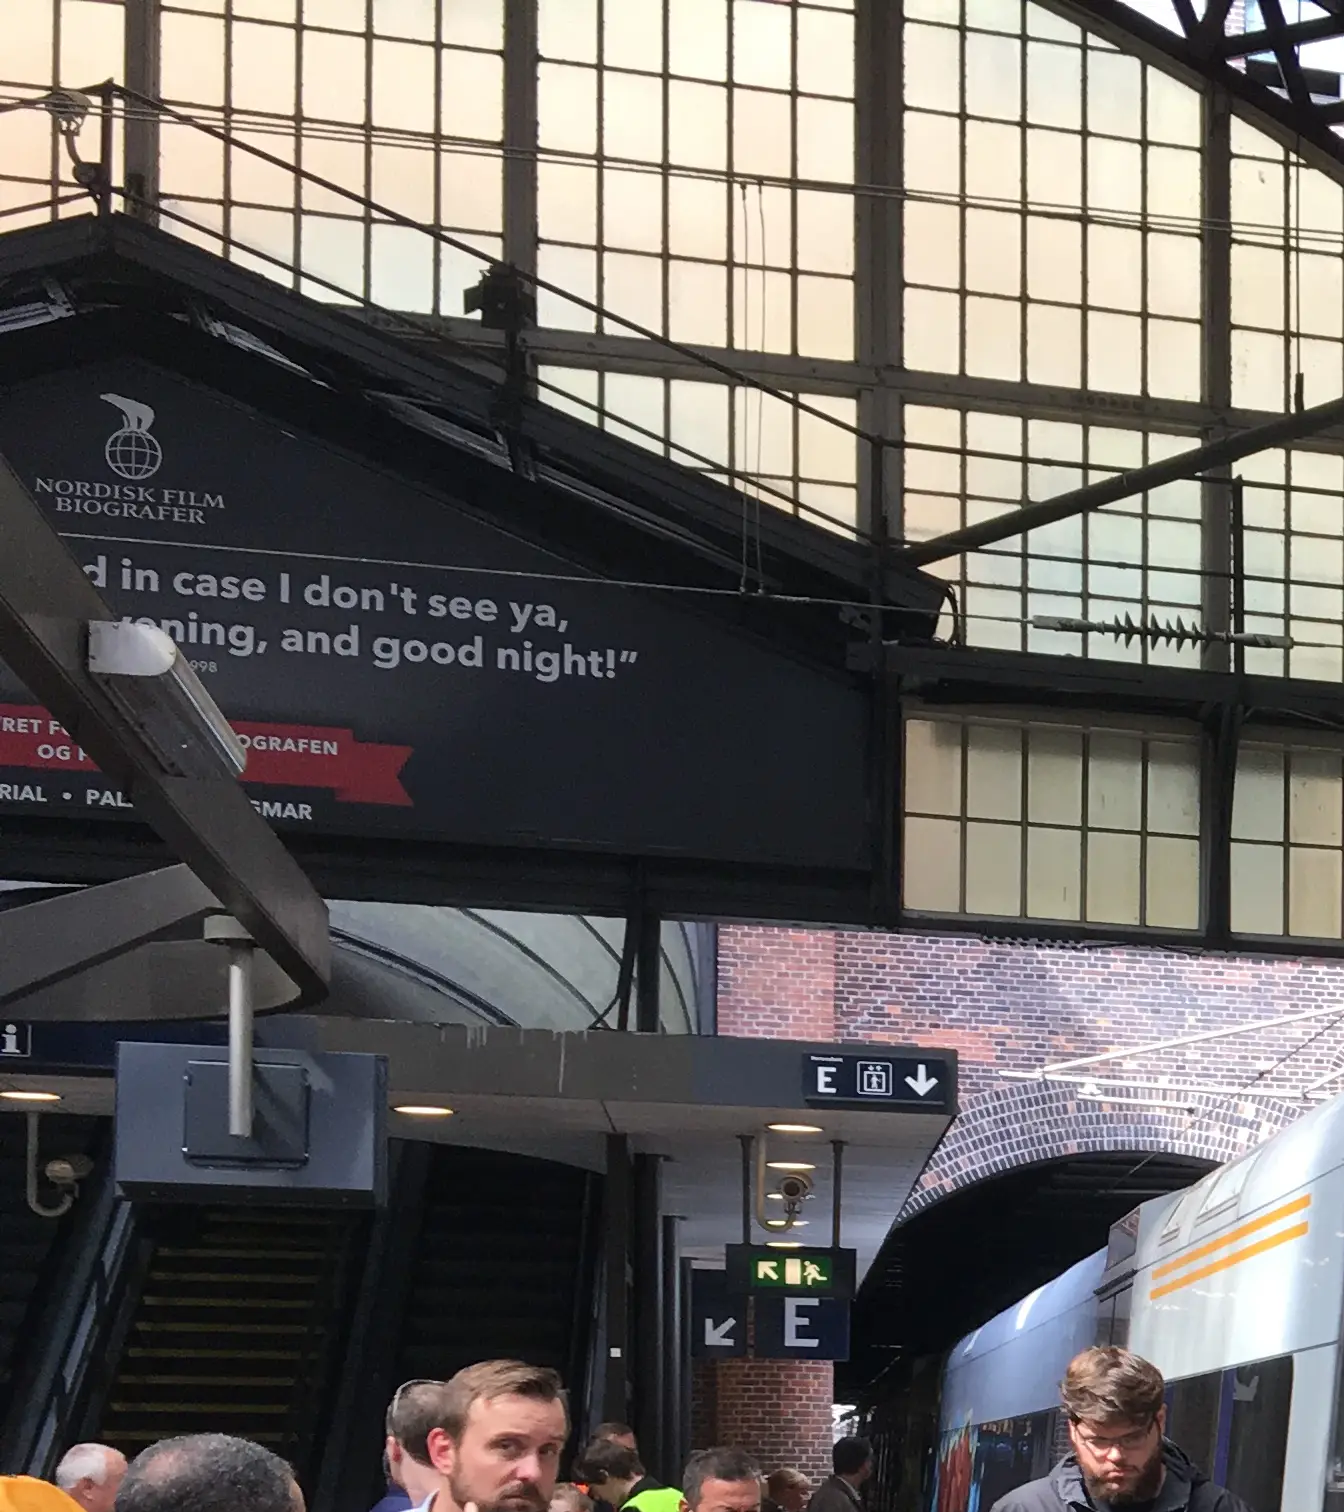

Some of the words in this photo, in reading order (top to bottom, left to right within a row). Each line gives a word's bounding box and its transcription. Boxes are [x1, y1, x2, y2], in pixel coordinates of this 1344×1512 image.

[35, 477, 156, 503] NORDISK
[162, 489, 225, 509] FILM
[56, 497, 206, 525] BIOGRAFER
[83, 555, 107, 588] d
[121, 558, 159, 592] in
[172, 572, 267, 601] case
[280, 572, 290, 604] I
[303, 575, 418, 616] don't
[427, 593, 499, 622] see
[508, 601, 569, 633] ya,
[122, 612, 268, 657] ning,
[281, 624, 359, 657] and
[372, 636, 484, 669] good
[189, 659, 218, 673] 998
[0, 715, 43, 735] RET
[236, 733, 338, 756] OGRAFEN
[37, 743, 71, 761] OG
[86, 788, 134, 808] PAL
[250, 800, 313, 821] MAR
[816, 1066, 837, 1093] E
[784, 1296, 820, 1348] E
